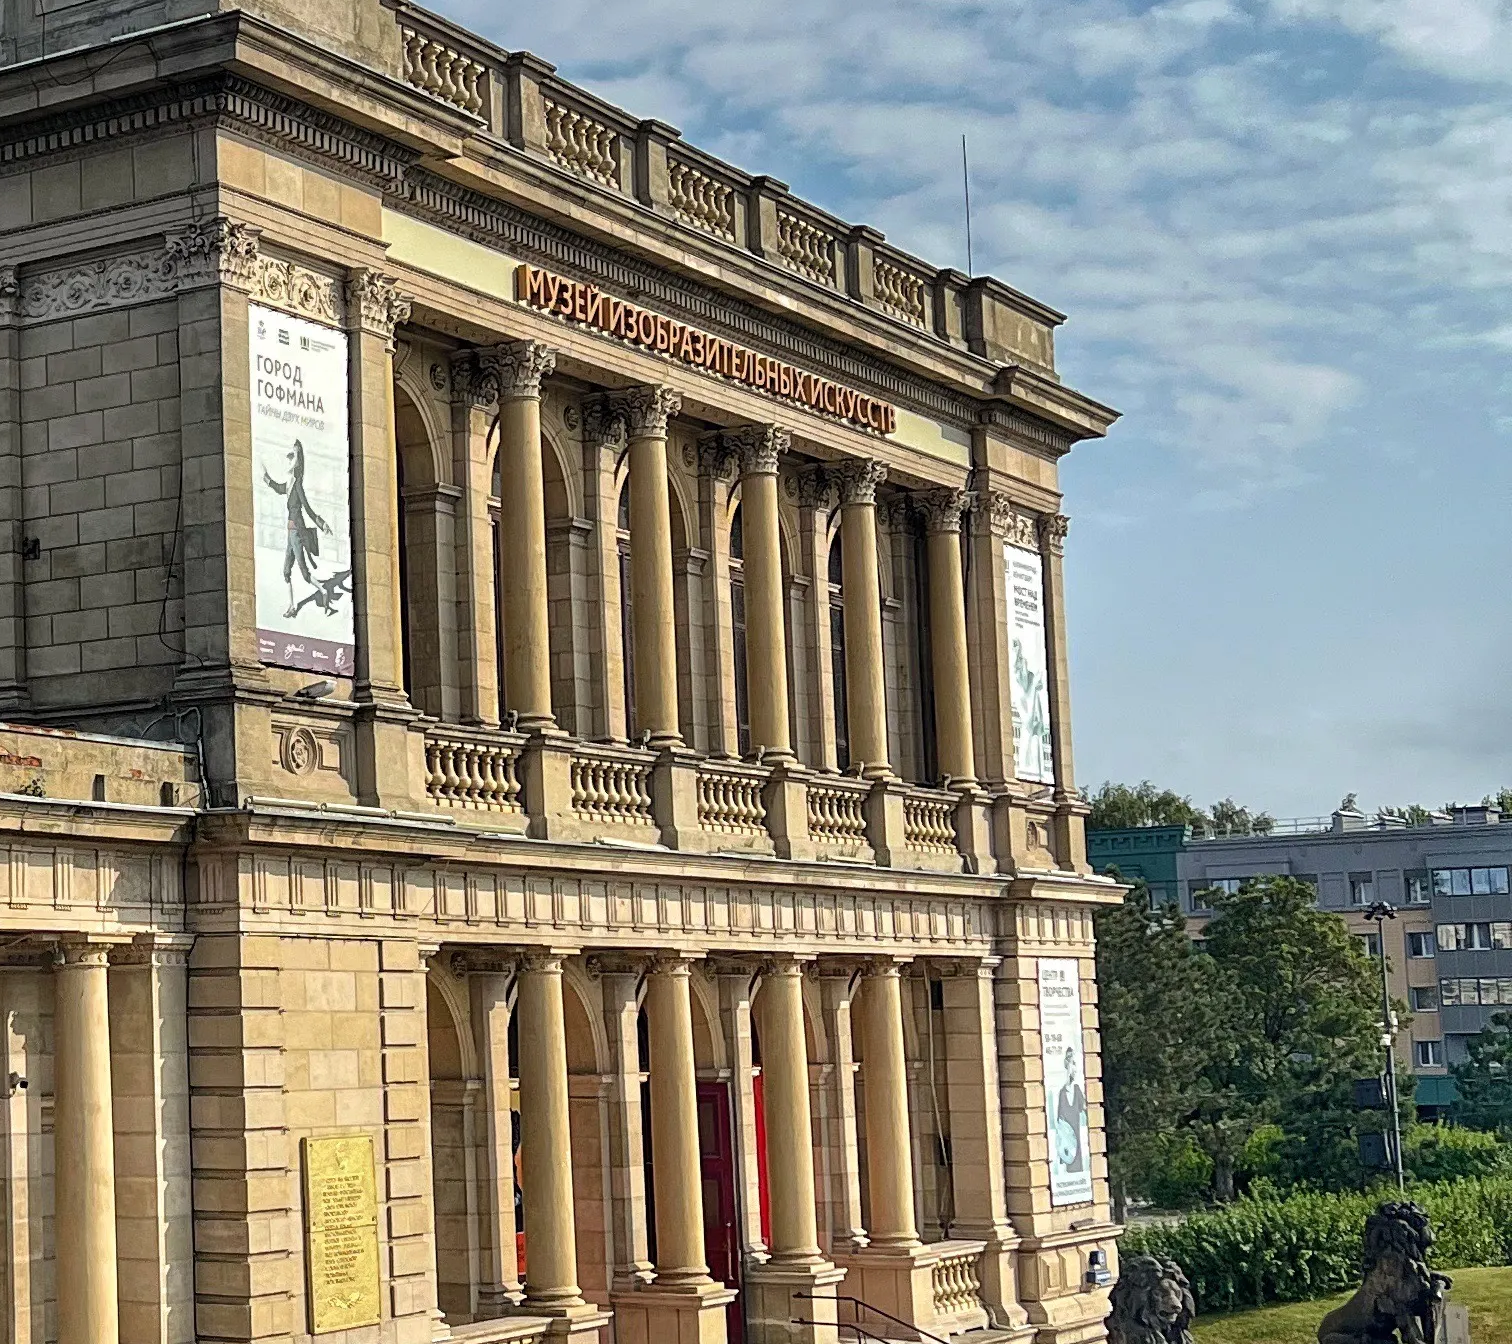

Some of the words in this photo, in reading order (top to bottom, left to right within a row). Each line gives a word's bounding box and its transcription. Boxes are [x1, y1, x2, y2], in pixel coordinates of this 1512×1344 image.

[523, 263, 604, 327] МУЗЕЙ
[608, 296, 807, 402] ИЗОБРАЗИТЕЛЬНЫХ
[809, 375, 897, 433] ИСКУССТВ
[257, 354, 303, 388] ГОРОД
[257, 379, 324, 413] ГОФМАНА
